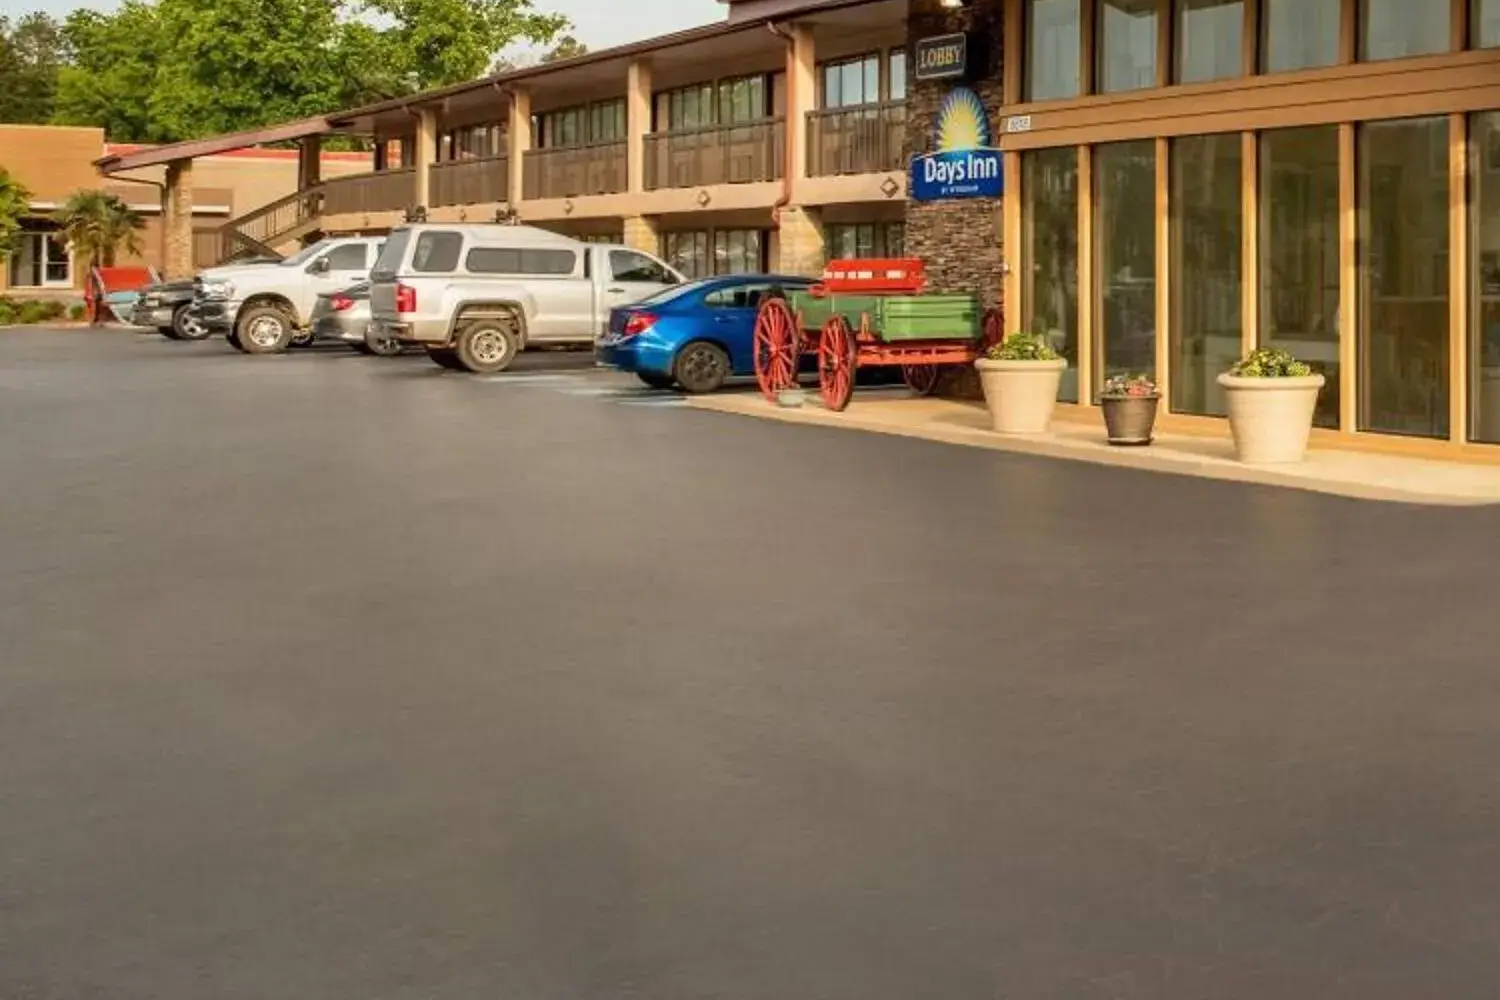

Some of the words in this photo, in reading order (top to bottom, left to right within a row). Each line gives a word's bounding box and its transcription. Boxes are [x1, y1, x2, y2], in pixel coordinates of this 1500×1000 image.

[921, 45, 961, 68] LOBBY
[924, 157, 965, 185] Days
[967, 153, 998, 179] Inn
